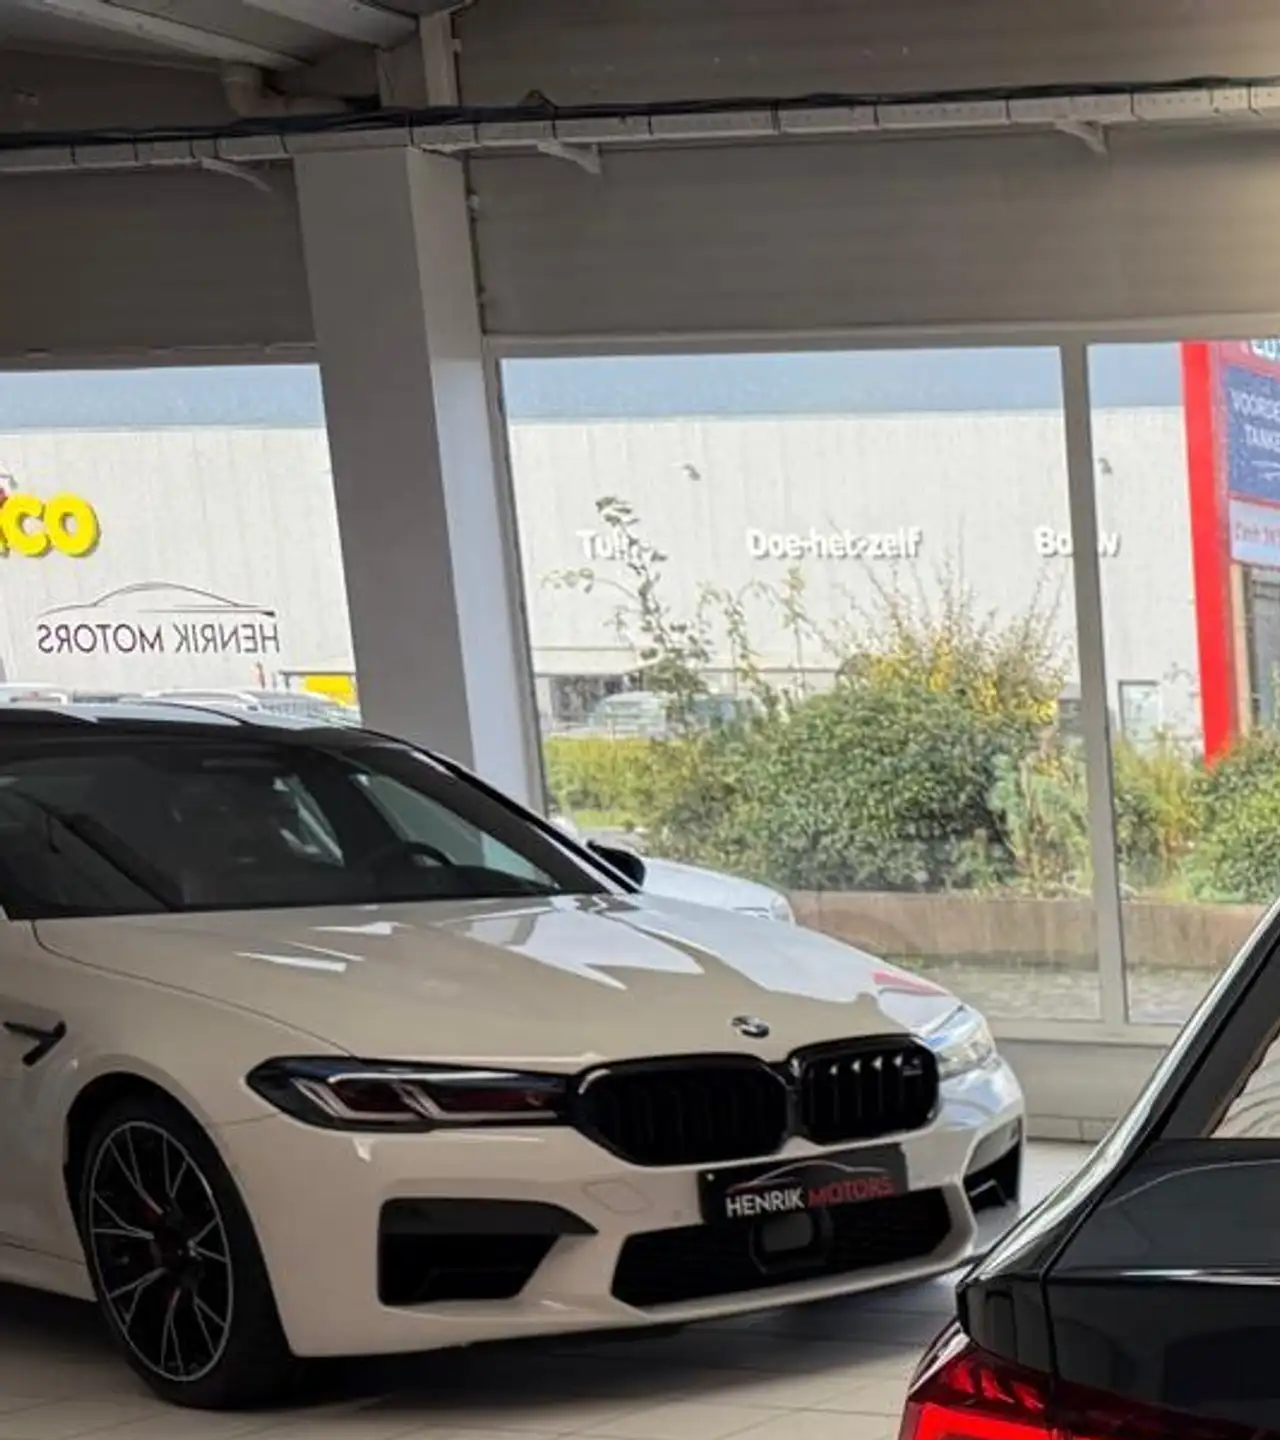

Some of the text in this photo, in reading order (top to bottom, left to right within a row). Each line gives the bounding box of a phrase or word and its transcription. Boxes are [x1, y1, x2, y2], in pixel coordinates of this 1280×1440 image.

[1034, 526, 1121, 558] Bow
[725, 1176, 895, 1217] HENRIK MOTORS
